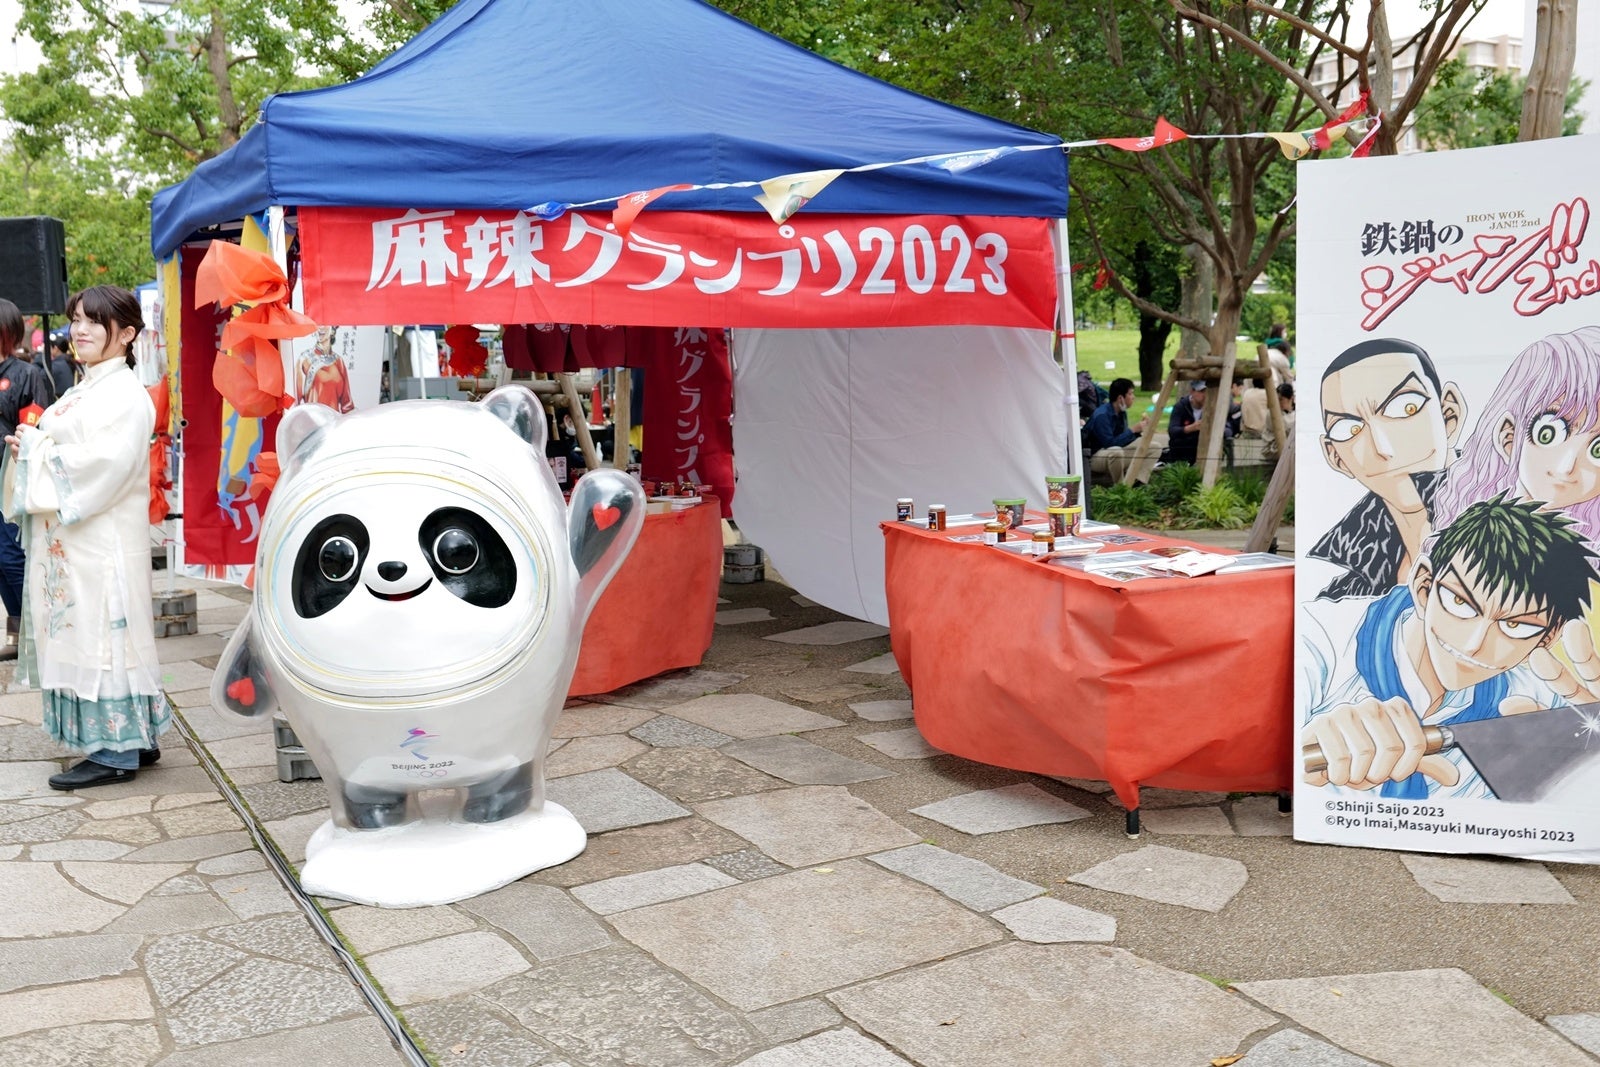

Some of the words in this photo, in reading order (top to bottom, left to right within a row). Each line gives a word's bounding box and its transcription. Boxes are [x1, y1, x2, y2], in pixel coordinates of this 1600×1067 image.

[1466, 212, 1496, 223] IRON
[1498, 210, 1525, 220] WOK
[1489, 219, 1519, 230] JAN!!
[1521, 217, 1541, 227] 2nd
[1360, 218, 1464, 257] 鉄鍋の
[364, 207, 1010, 298] 麻辣グランプリ2023
[1513, 258, 1600, 317] 2nd
[391, 763, 427, 771] BEIJING
[429, 760, 456, 769] 2022
[1377, 803, 1409, 817] Saijo
[1412, 805, 1445, 818] 2023
[1465, 824, 1537, 839] Murayoshi
[1540, 829, 1575, 843] 2023
